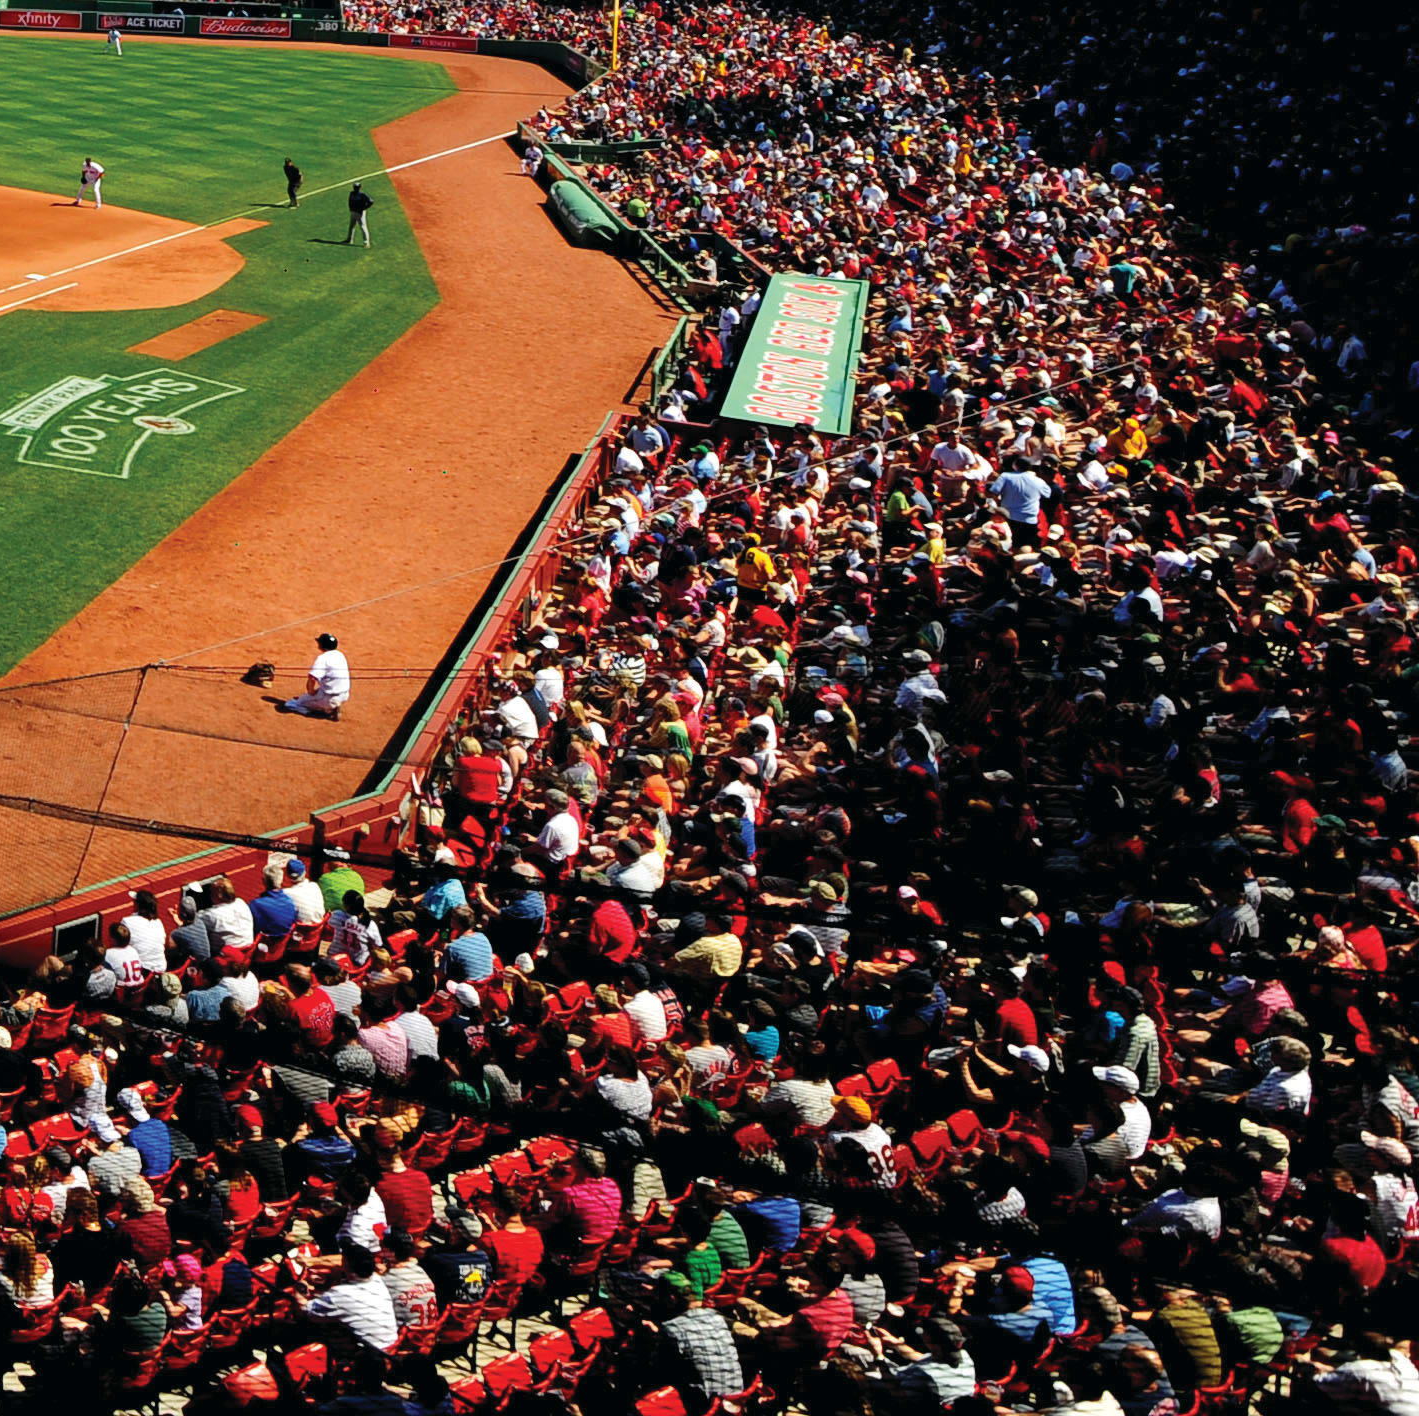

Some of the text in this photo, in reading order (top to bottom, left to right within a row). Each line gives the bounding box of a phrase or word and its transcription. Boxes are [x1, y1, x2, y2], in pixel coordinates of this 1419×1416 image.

[18, 12, 61, 27] xfinity
[126, 18, 146, 27] ACE
[149, 18, 181, 29] TICKET
[205, 19, 287, 33] Budweiser
[318, 22, 338, 31] 380
[744, 291, 844, 427] BOSTON RED SOX
[15, 381, 85, 426] FENWAY PARK
[45, 378, 199, 462] 100 YEARS
